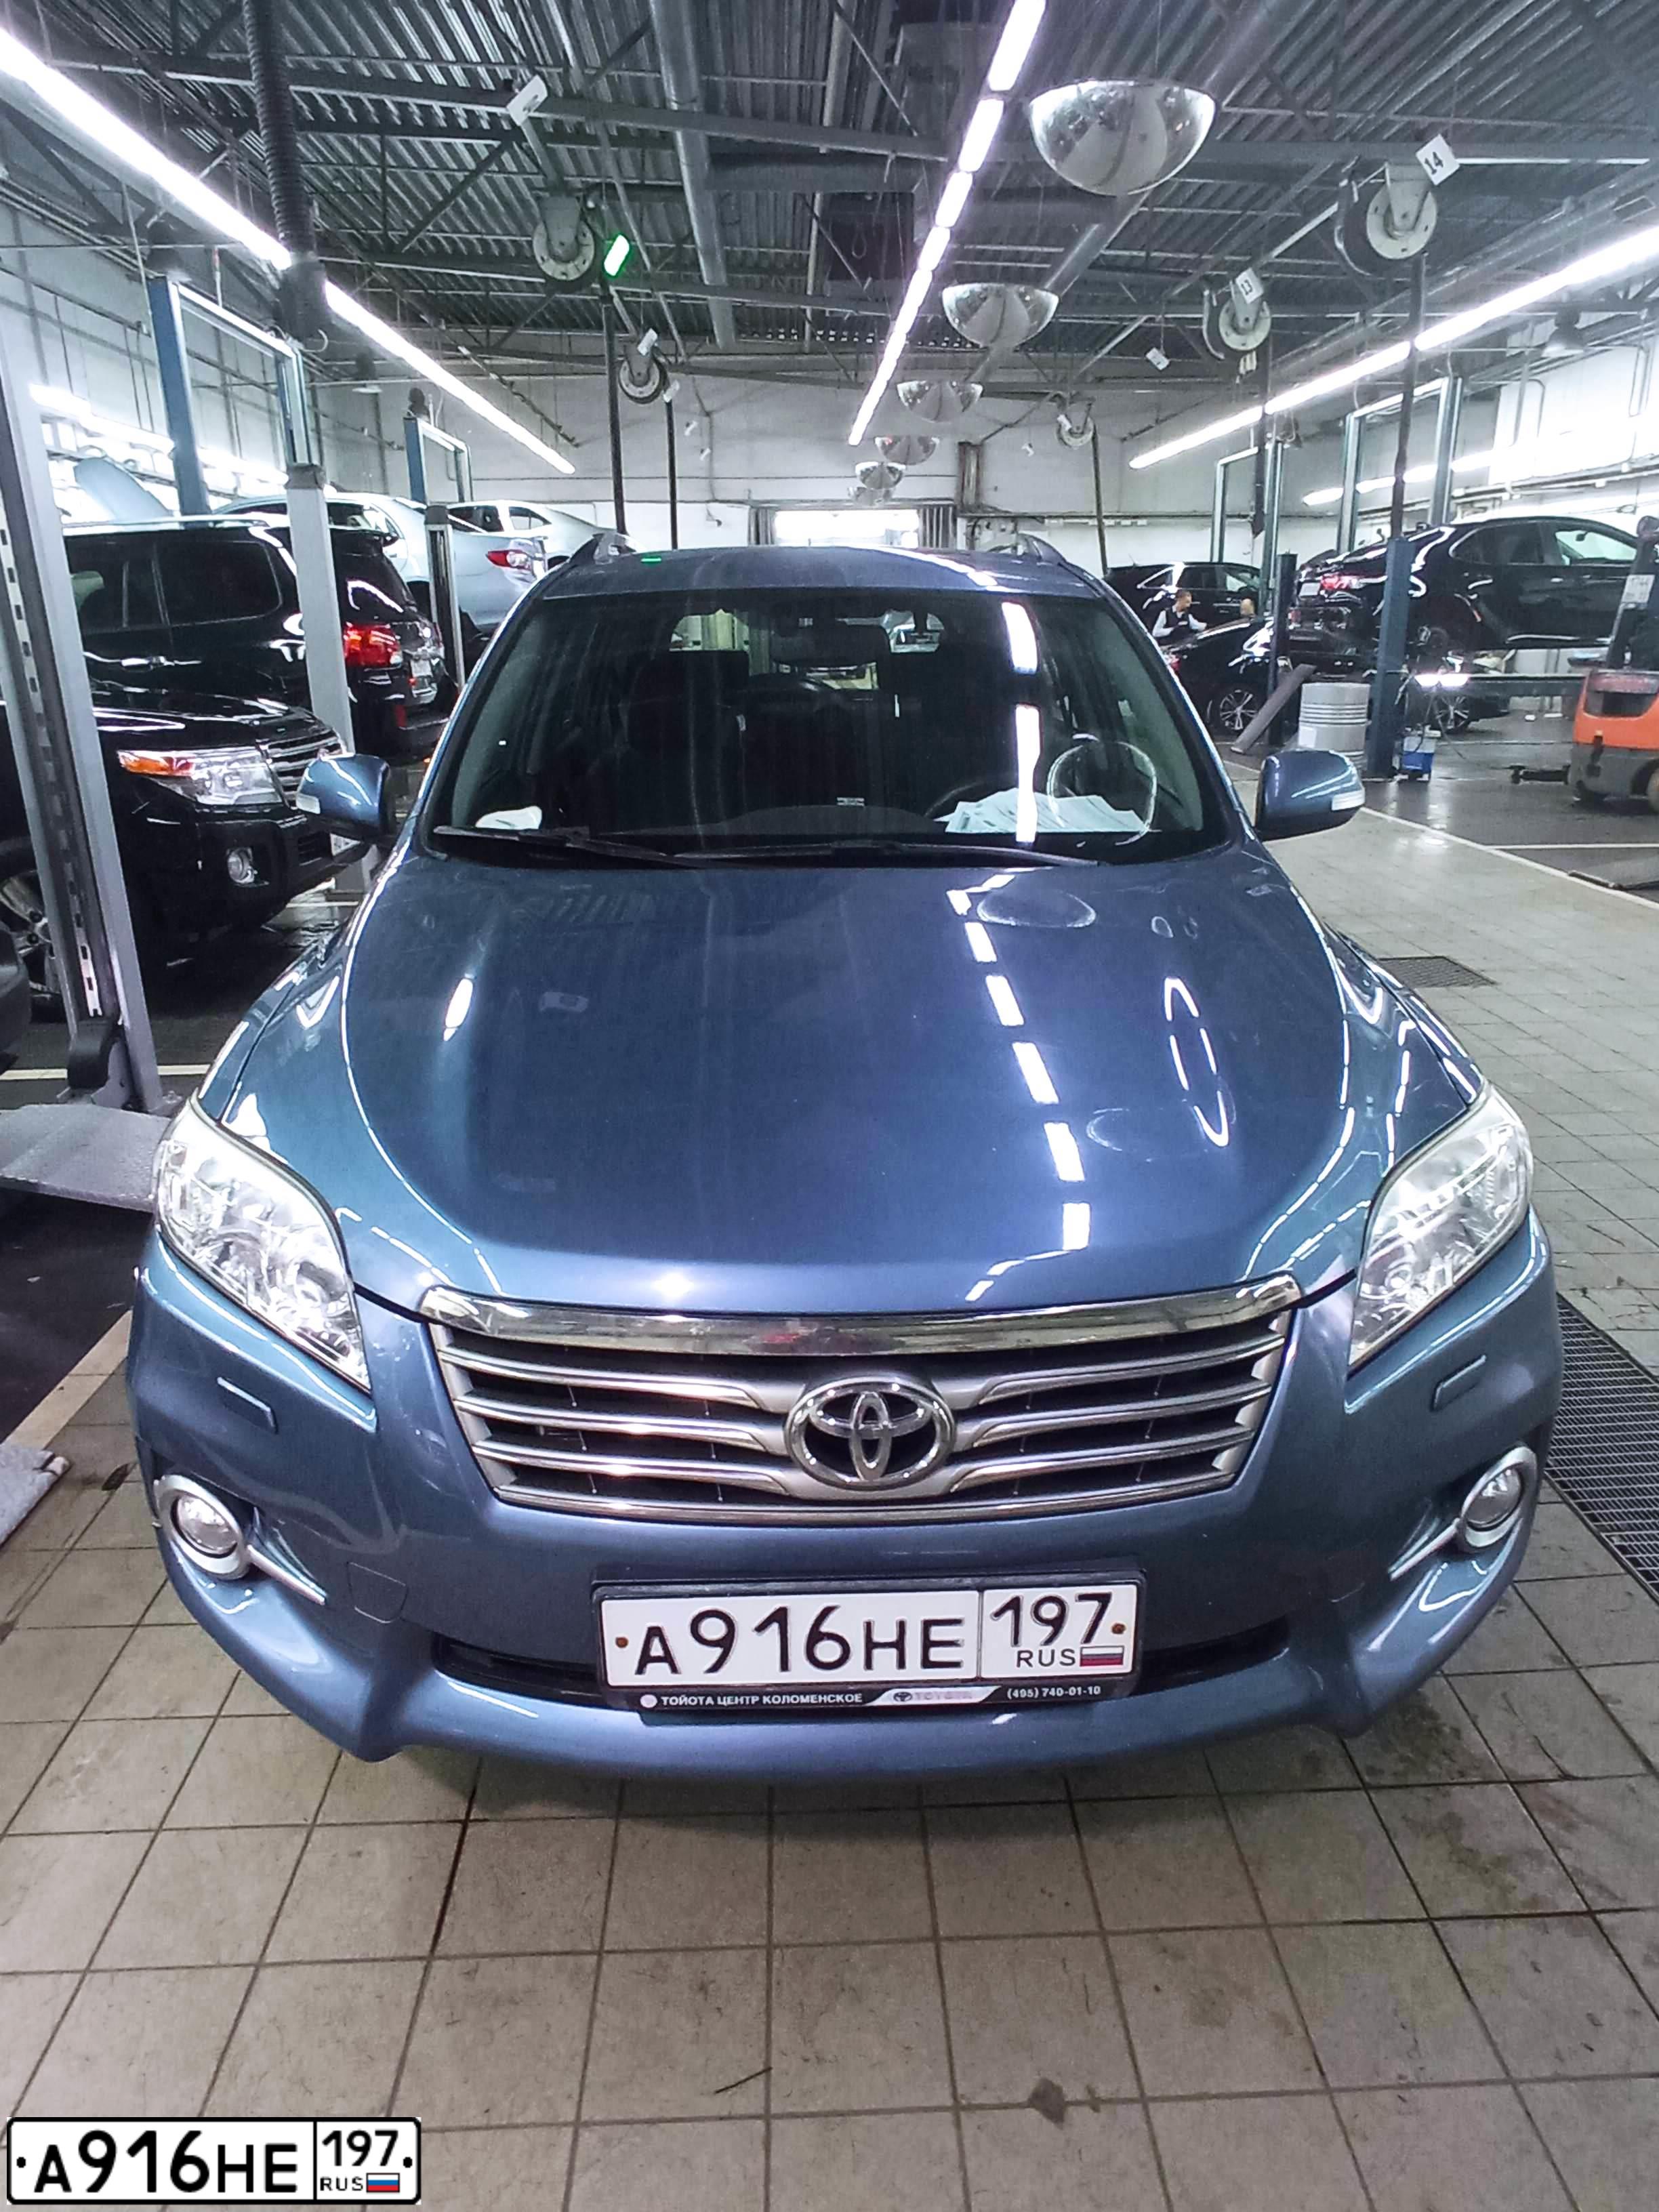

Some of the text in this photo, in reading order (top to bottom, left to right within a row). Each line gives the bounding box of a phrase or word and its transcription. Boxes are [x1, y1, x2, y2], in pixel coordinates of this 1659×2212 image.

[1424, 151, 1444, 176] 14
[634, 1593, 1114, 1675] А916НЕ 197
[1017, 1647, 1076, 1668] RUS
[661, 1693, 863, 1706] ТОЙОТА ЦЕНТР КОЛОМЕНСКОЕ
[1007, 1686, 1101, 1699] (495) 740-01-10
